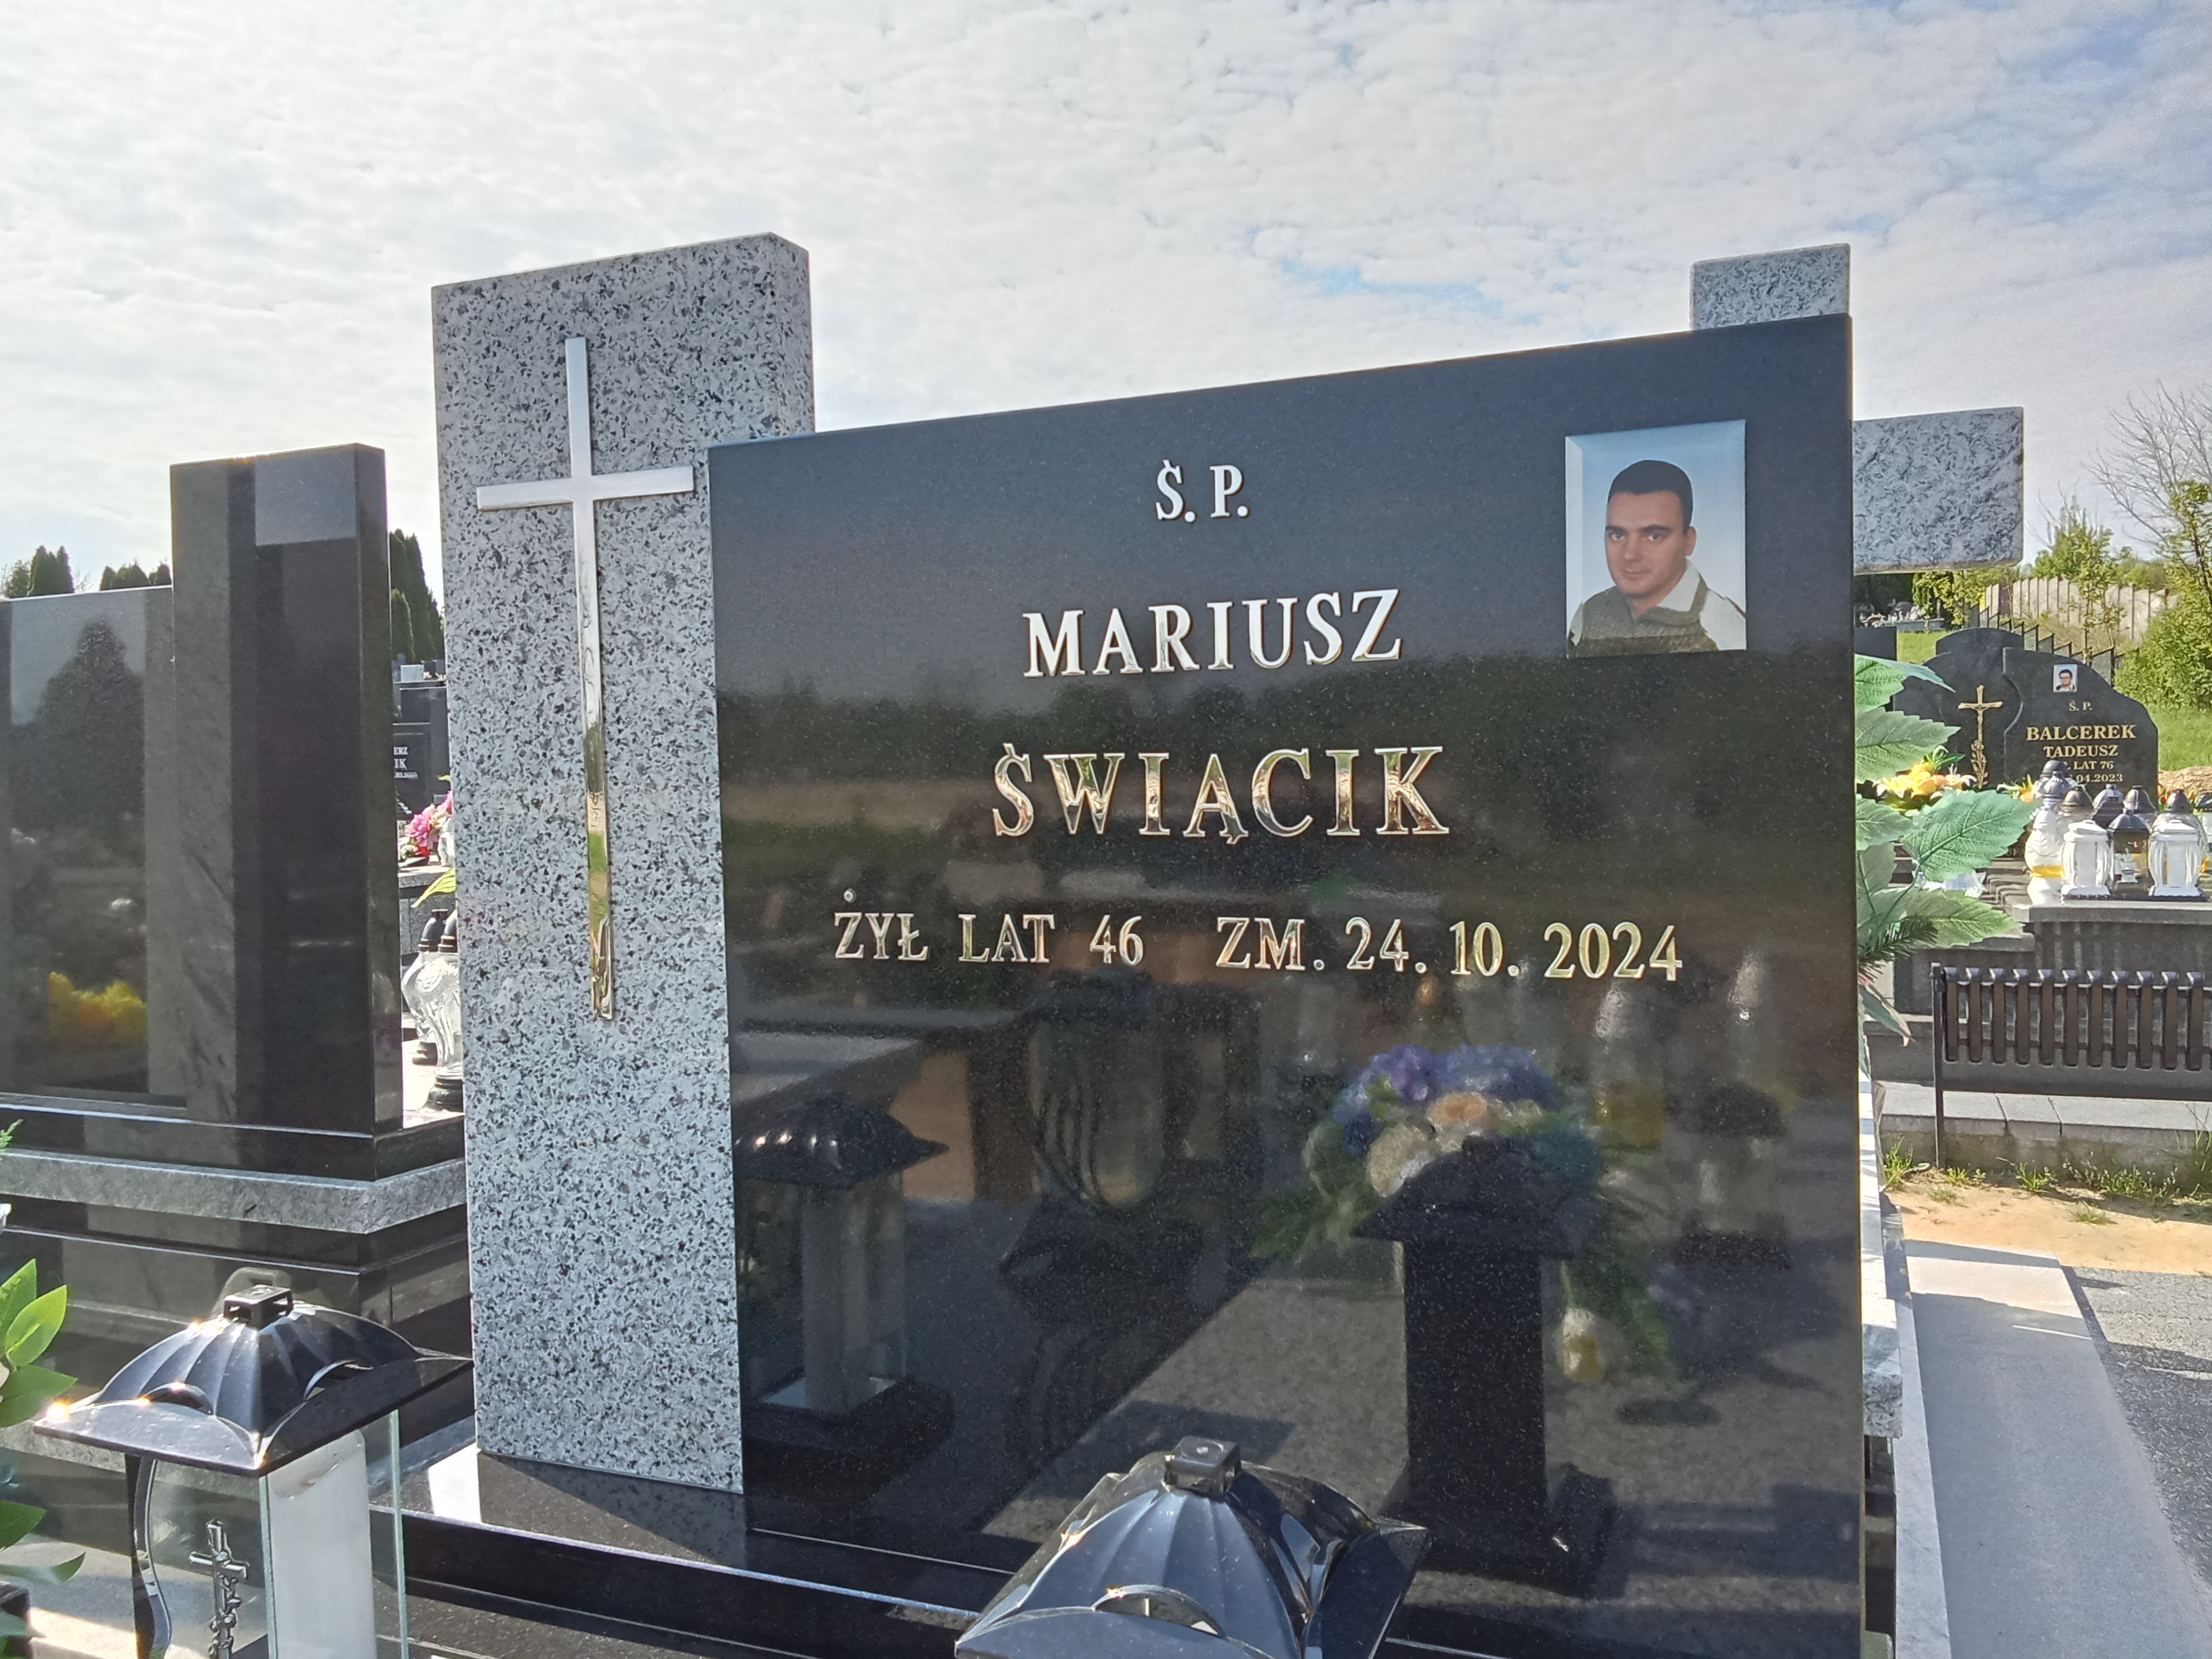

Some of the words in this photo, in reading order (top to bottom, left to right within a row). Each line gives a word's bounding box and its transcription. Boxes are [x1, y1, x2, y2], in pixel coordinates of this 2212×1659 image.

[1022, 588, 1403, 678] MARIUSZ
[2026, 724, 2137, 741] BALCEREK
[2043, 745, 2118, 758] TADEUSZ
[2074, 760, 2097, 770] LAT
[2100, 760, 2114, 770] 76
[991, 742, 1450, 845] ŚWIĄCIK
[834, 888, 928, 962] ŻYŁ
[957, 913, 1056, 964] LAT
[1088, 914, 1144, 966] 46
[1215, 916, 1326, 972] ZM.
[1345, 916, 1427, 975] 24.
[1449, 920, 1521, 977] 10.
[1543, 921, 1684, 982] 2024
